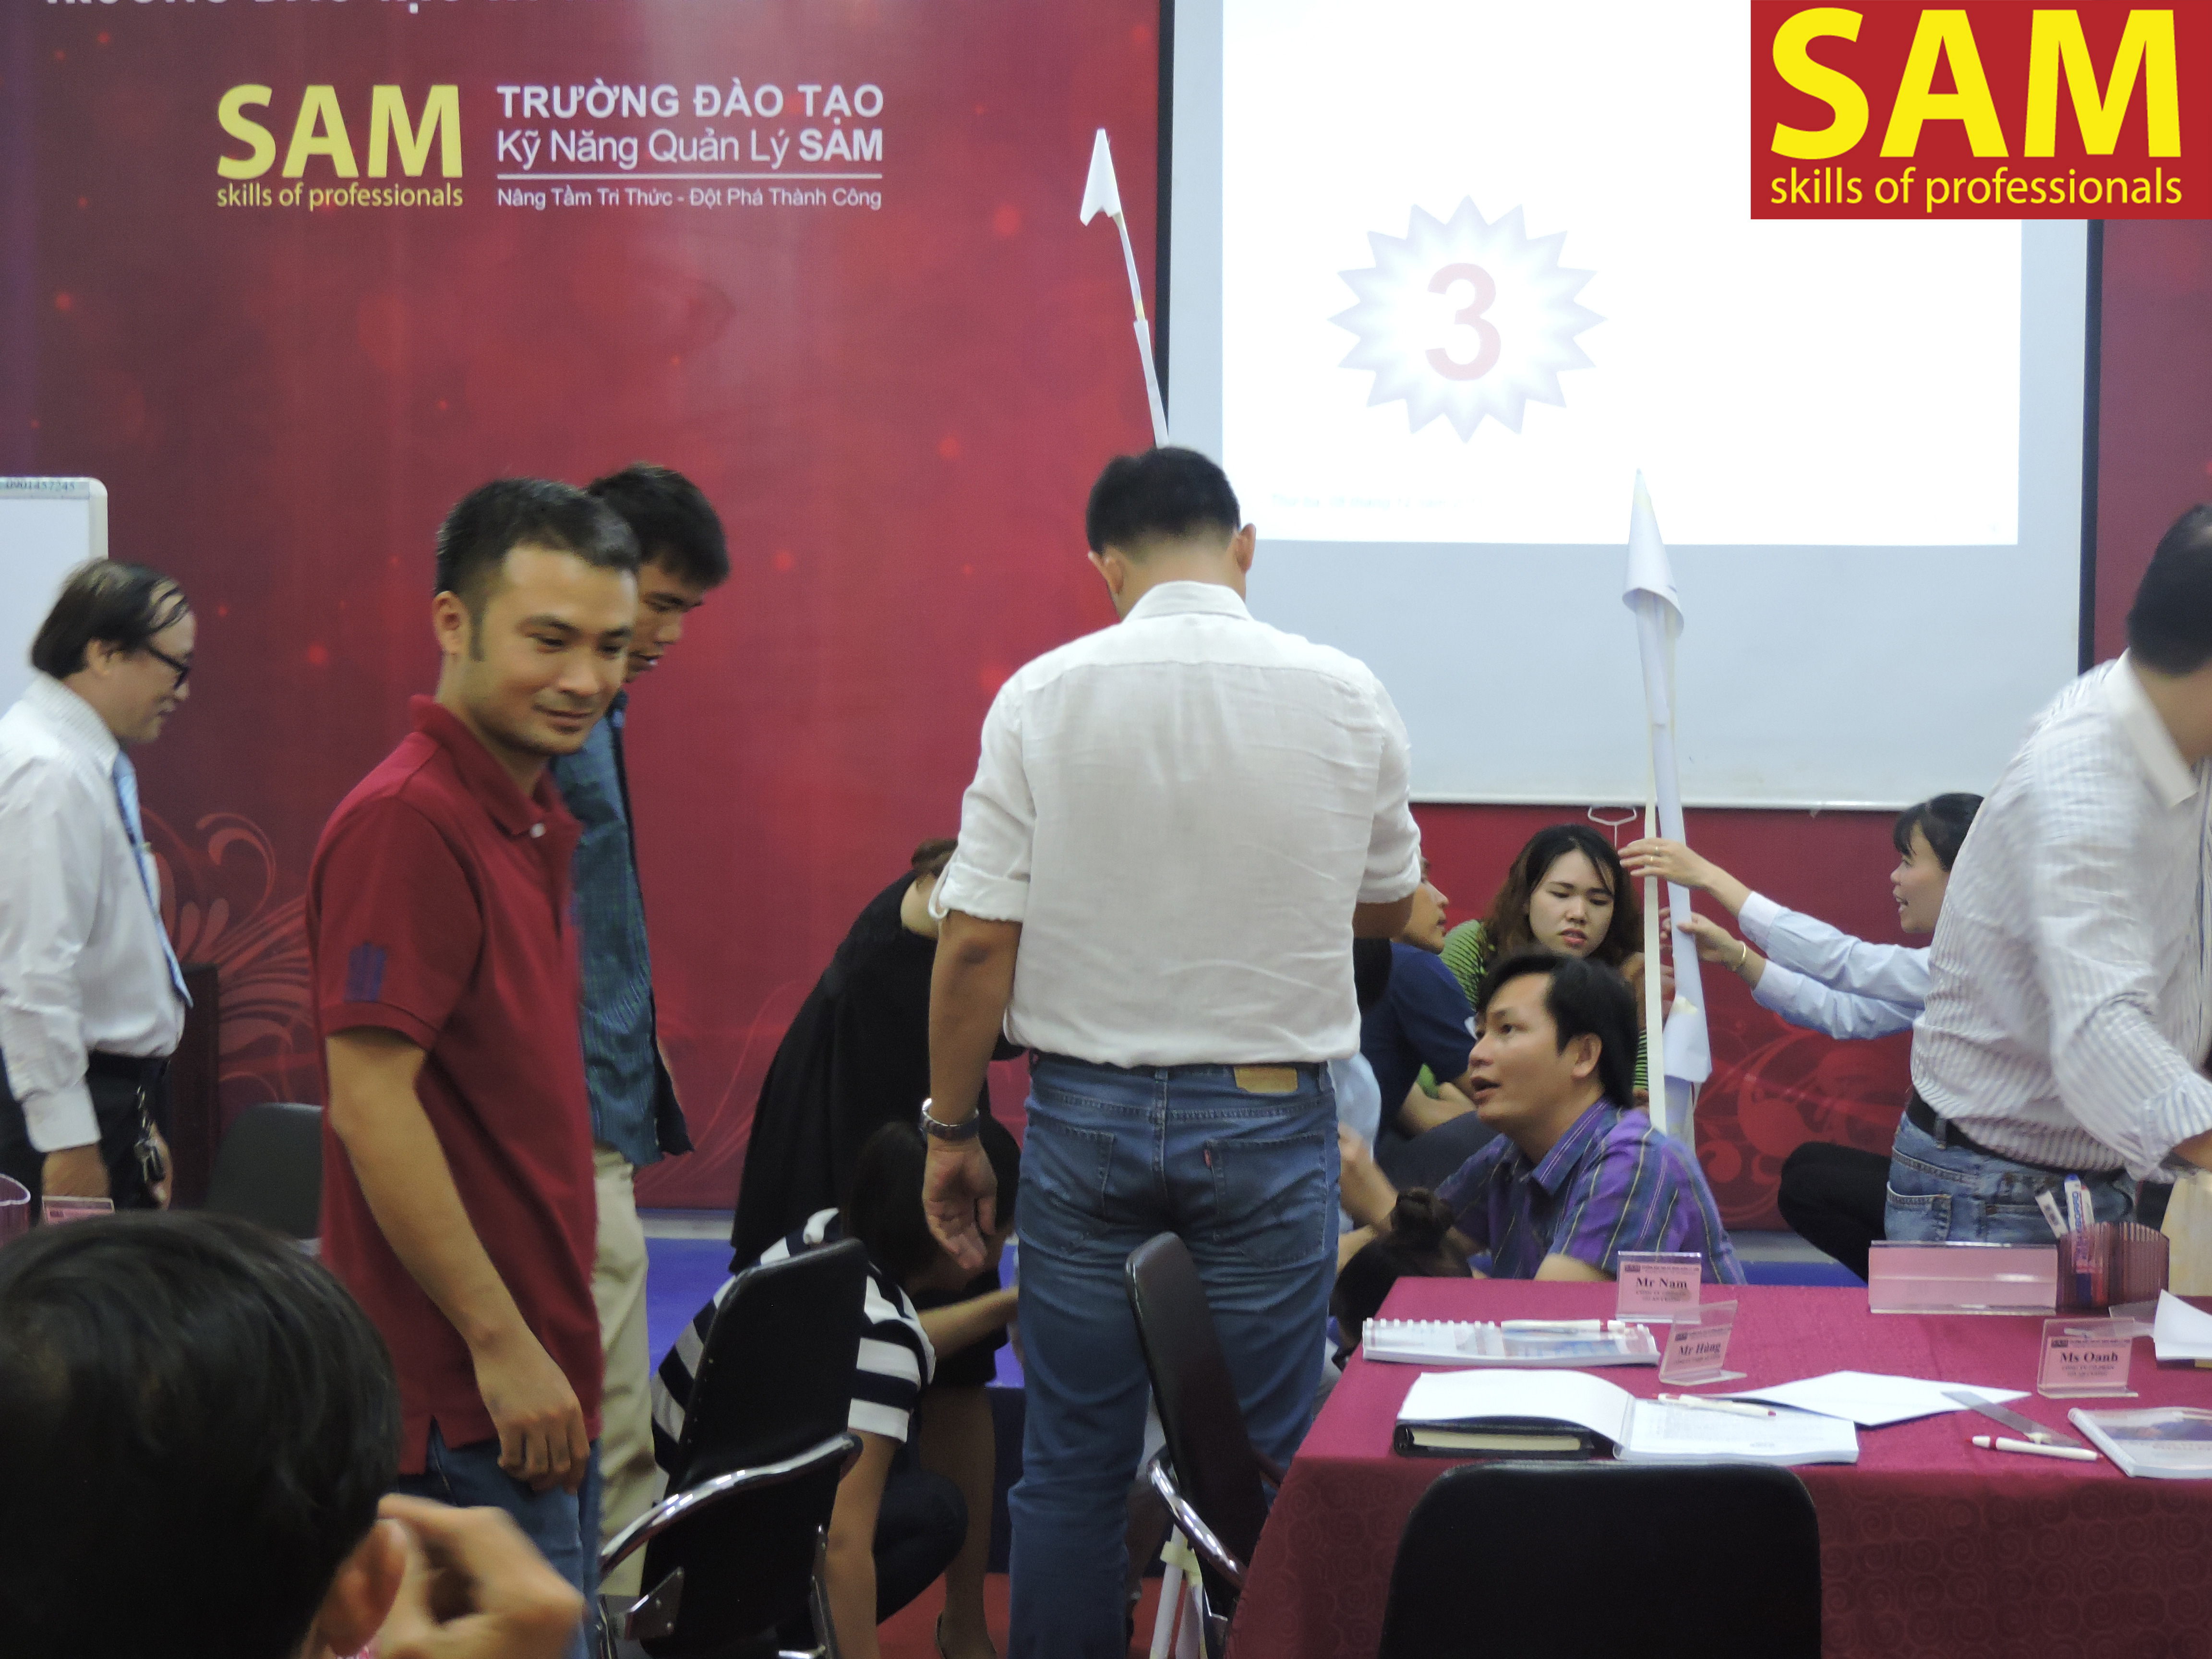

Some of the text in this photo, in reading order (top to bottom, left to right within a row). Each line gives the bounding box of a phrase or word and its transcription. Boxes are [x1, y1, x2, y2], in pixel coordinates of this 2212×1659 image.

[497, 77, 884, 125] TRƯỜNG ĐÀO TẠO
[217, 84, 463, 179] SAM
[498, 127, 883, 170] Kỹ Năng Quản Lý SAM
[217, 182, 463, 211] skills of professionals
[497, 188, 546, 211] Nâng
[690, 188, 722, 210] Đột
[832, 188, 882, 211] Công
[1425, 263, 1502, 381] 3
[1636, 1277, 1687, 1289] Mr Nam
[1679, 1344, 1694, 1356] Mr
[2060, 1350, 2119, 1363] Ms Oanh
